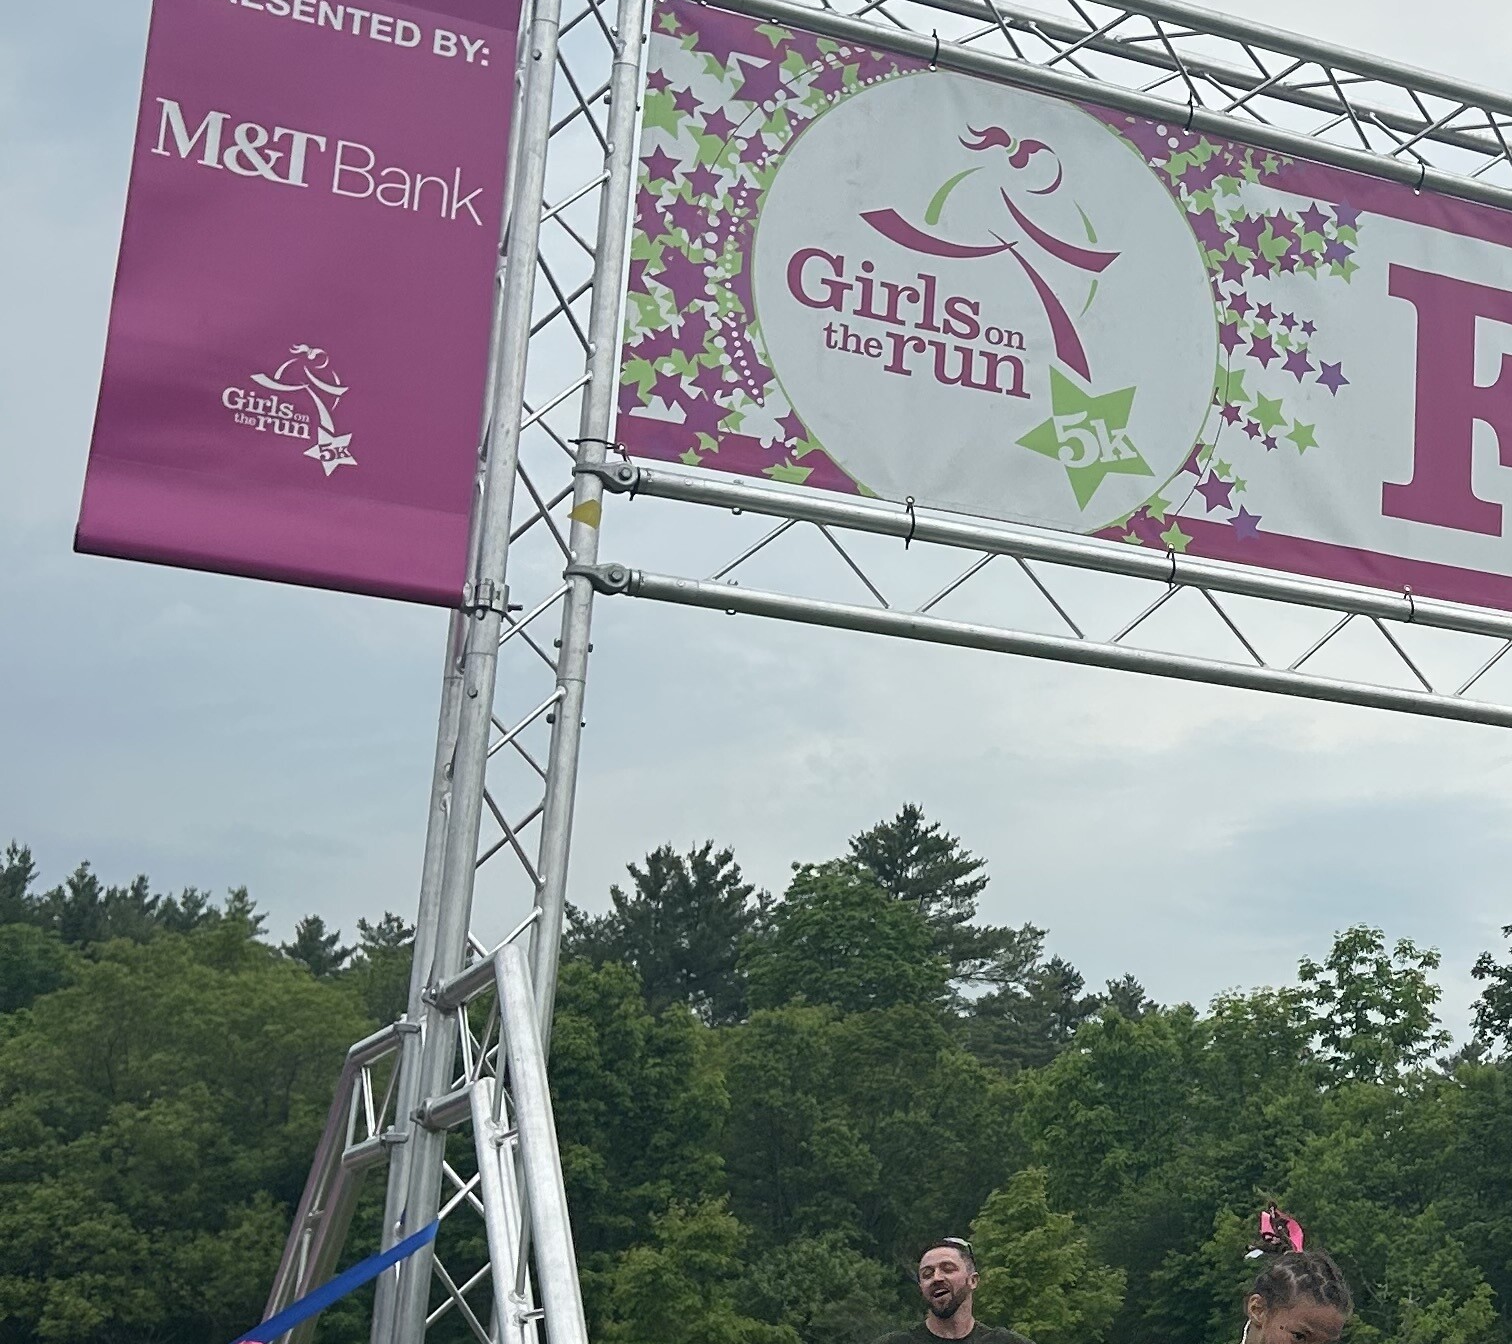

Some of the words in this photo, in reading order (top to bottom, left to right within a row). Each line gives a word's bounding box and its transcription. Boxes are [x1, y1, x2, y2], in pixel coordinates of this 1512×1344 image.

[433, 28, 490, 66] BY:
[151, 97, 327, 187] M&T
[332, 139, 483, 226] Bank
[786, 247, 980, 340] Girls
[984, 326, 1026, 352] on
[823, 321, 883, 358] the
[882, 332, 1031, 400] run
[222, 387, 294, 419] Girls
[293, 413, 310, 423] on
[234, 412, 256, 426] the
[255, 416, 311, 440] run
